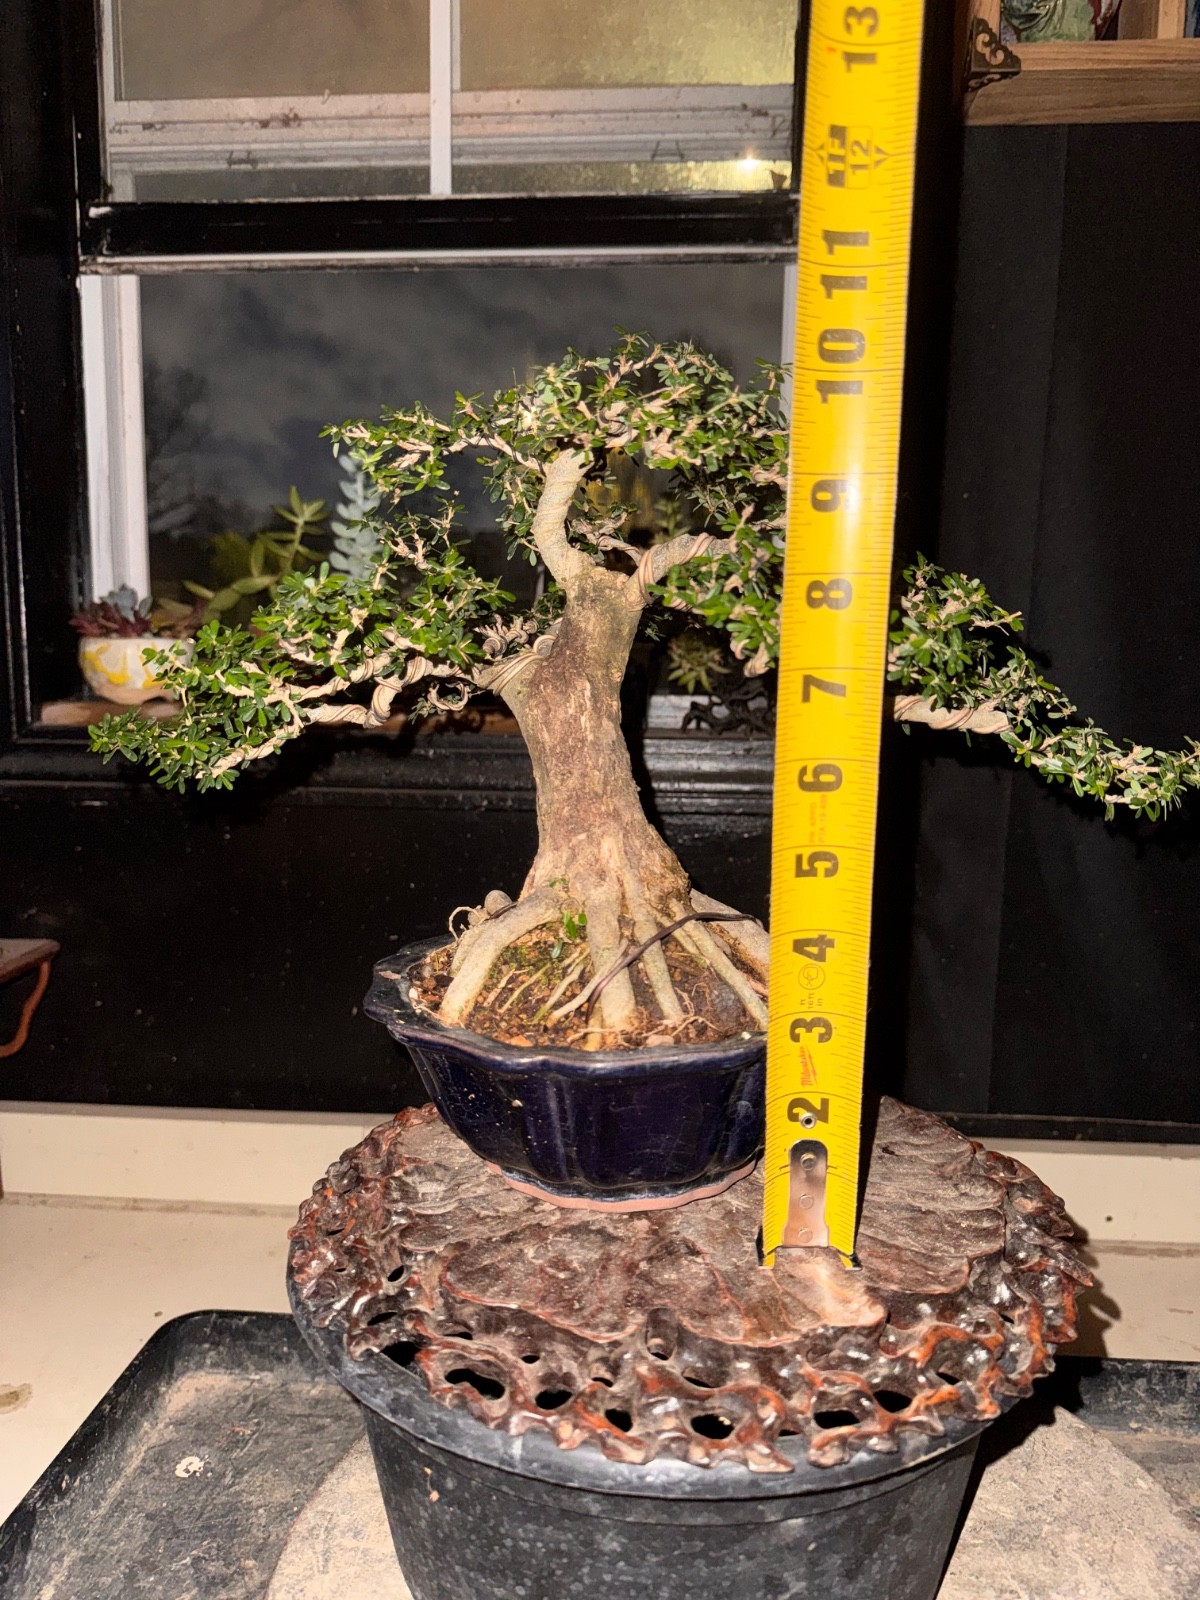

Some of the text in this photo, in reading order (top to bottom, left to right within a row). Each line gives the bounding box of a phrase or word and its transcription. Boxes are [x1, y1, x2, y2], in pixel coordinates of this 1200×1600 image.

[842, 6, 879, 73] 13
[850, 140, 870, 175] 12
[821, 229, 870, 300] 11
[816, 328, 866, 404] 10
[811, 479, 854, 513] 9
[806, 578, 853, 610] 8
[801, 674, 846, 703] 7
[797, 763, 843, 793] 6
[795, 851, 839, 878] 5
[792, 934, 835, 963] 4
[789, 1016, 833, 1043] 3
[787, 1097, 829, 1123] 2
